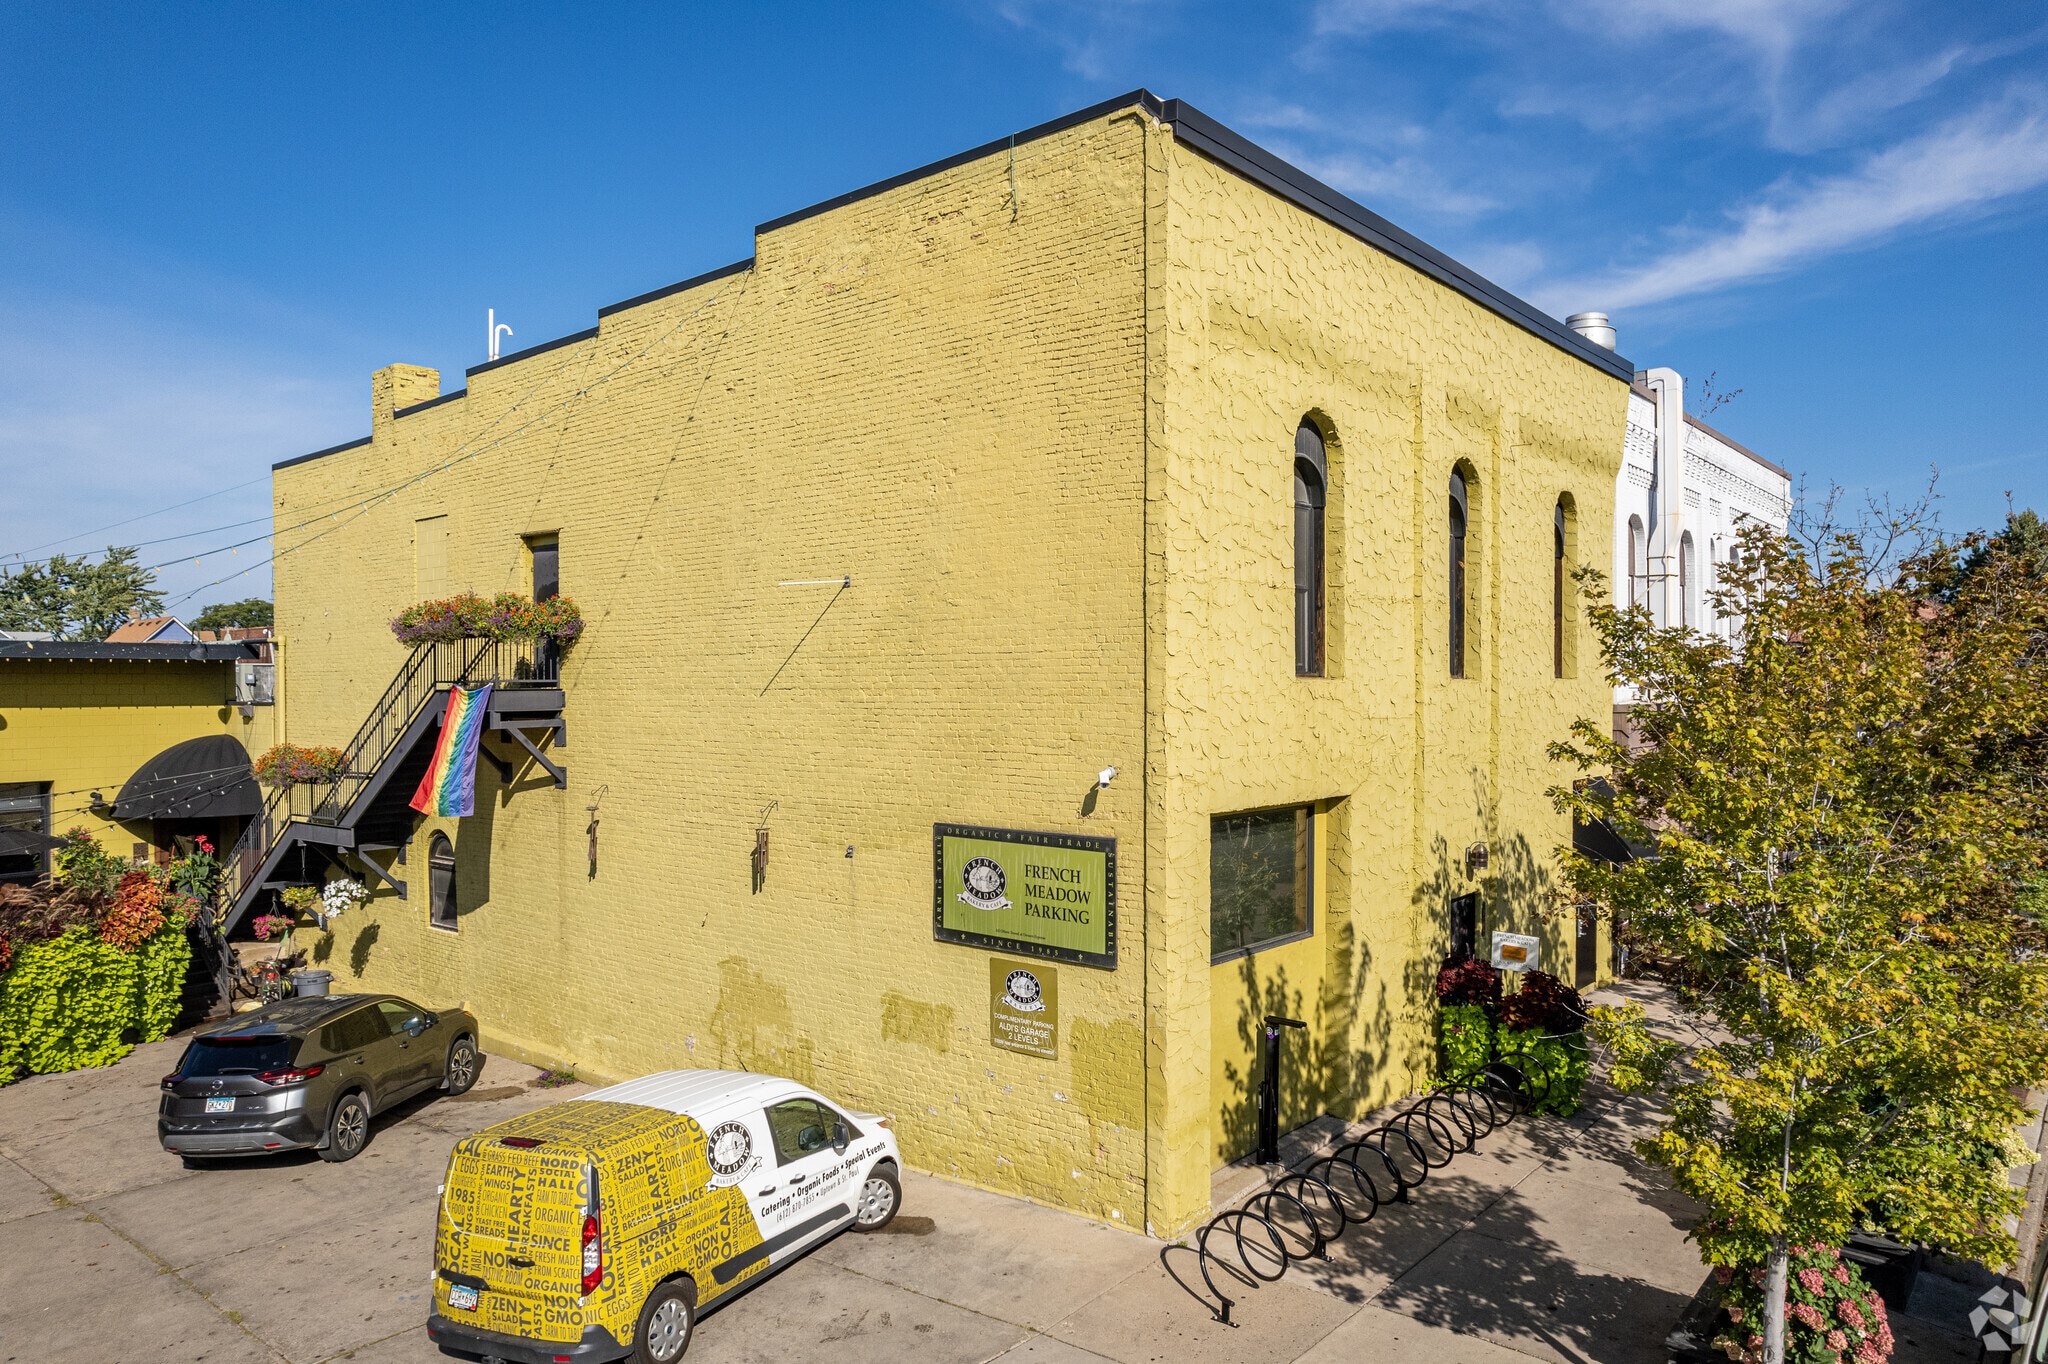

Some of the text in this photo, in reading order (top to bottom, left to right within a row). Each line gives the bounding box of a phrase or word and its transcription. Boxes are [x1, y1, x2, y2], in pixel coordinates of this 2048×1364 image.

[947, 827, 1100, 849] ORGANIC FAIR TRADE
[967, 859, 1002, 875] FRENCH
[1024, 864, 1081, 884] FRENCH
[965, 881, 1003, 900] MEADOW
[1024, 883, 1091, 905] MEADOW
[967, 896, 985, 909] BAKERY
[1025, 903, 1090, 925] PARKING
[983, 937, 1059, 957] SINCE 1985
[1009, 970, 1037, 984] FRENCH
[1008, 989, 1038, 1004] MEADOW
[994, 1013, 1054, 1030] COMPLIMENTARY PARKING
[999, 1022, 1049, 1039] ALDI'S GARAGE
[1008, 1032, 1039, 1045] 2 LEVELS
[658, 1121, 687, 1141] NORD
[709, 1124, 745, 1148] FRENCH
[526, 1146, 582, 1158] ORGANIC
[611, 1131, 659, 1158] GRASS FED BEEF
[460, 1158, 479, 1175] EGGS
[488, 1150, 539, 1166] GRASS FED BEEF
[540, 1157, 579, 1170] NORD
[616, 1151, 641, 1173] ZEN
[665, 1145, 699, 1172] ORGANIC
[713, 1147, 750, 1174] MEADOW
[486, 1164, 514, 1178] EARTH
[539, 1168, 576, 1178] SOCIAL
[618, 1166, 644, 1184] SALAD
[716, 1176, 736, 1185] BAKERY
[761, 1195, 791, 1217] Catering
[797, 1176, 821, 1197] Organic
[822, 1166, 840, 1183] Foods
[845, 1149, 866, 1170] Special
[866, 1141, 886, 1157] Events
[484, 1178, 511, 1191] WINGS
[538, 1178, 574, 1190] HALL
[620, 1176, 647, 1197] ORGANIC
[642, 1150, 667, 1228] HEARTY
[654, 1143, 676, 1222] BREAKFASTS
[451, 1187, 475, 1204] 1985
[482, 1189, 509, 1205] ORGANIC
[622, 1191, 649, 1210] CHICKEN
[673, 1186, 704, 1210] SINCE
[699, 1197, 713, 1211] MADE
[714, 1190, 728, 1204] FOOD
[776, 1208, 791, 1223] (612)
[820, 1181, 836, 1196] Uptown
[848, 1166, 860, 1179] Paul
[452, 1203, 465, 1215] FOOD
[481, 1203, 508, 1218] CHICKEN
[504, 1167, 526, 1252] HEARTY
[519, 1168, 537, 1254] BREAKFASTS
[535, 1207, 574, 1225] ORGANIC
[621, 1203, 650, 1221] YEAST FREE
[698, 1208, 718, 1225] SCRATCH
[463, 1206, 473, 1250] WINGS
[475, 1217, 506, 1228] YEAST FREE
[609, 1208, 622, 1254] WINGS
[622, 1211, 652, 1232] BREADS
[720, 1201, 731, 1260] OCAL
[474, 1225, 506, 1239] BREADS
[638, 1222, 677, 1248] NORD
[685, 1220, 718, 1244] ORGANIC
[530, 1234, 570, 1252] SINCE
[639, 1233, 677, 1256] SOCIAL
[693, 1232, 718, 1256] NON
[471, 1249, 482, 1272] TABLE
[535, 1251, 580, 1266] FRESH MADE
[600, 1225, 616, 1304] LOCAL
[625, 1242, 639, 1268] TABLE
[641, 1243, 679, 1268] HALL
[650, 1260, 668, 1278] GRASS
[670, 1253, 682, 1267] FED
[682, 1245, 693, 1260] BEEF
[696, 1246, 719, 1270] GMO
[504, 1270, 523, 1286] ROOM
[535, 1265, 552, 1277] FROM
[616, 1256, 627, 1296] EARTH
[627, 1267, 641, 1281] TO
[524, 1278, 582, 1294] ORGANIC
[492, 1296, 517, 1313] ZEN
[543, 1294, 582, 1310] NON
[606, 1296, 631, 1317] EGGS
[492, 1312, 519, 1324] SALAD
[545, 1308, 583, 1326] GMO
